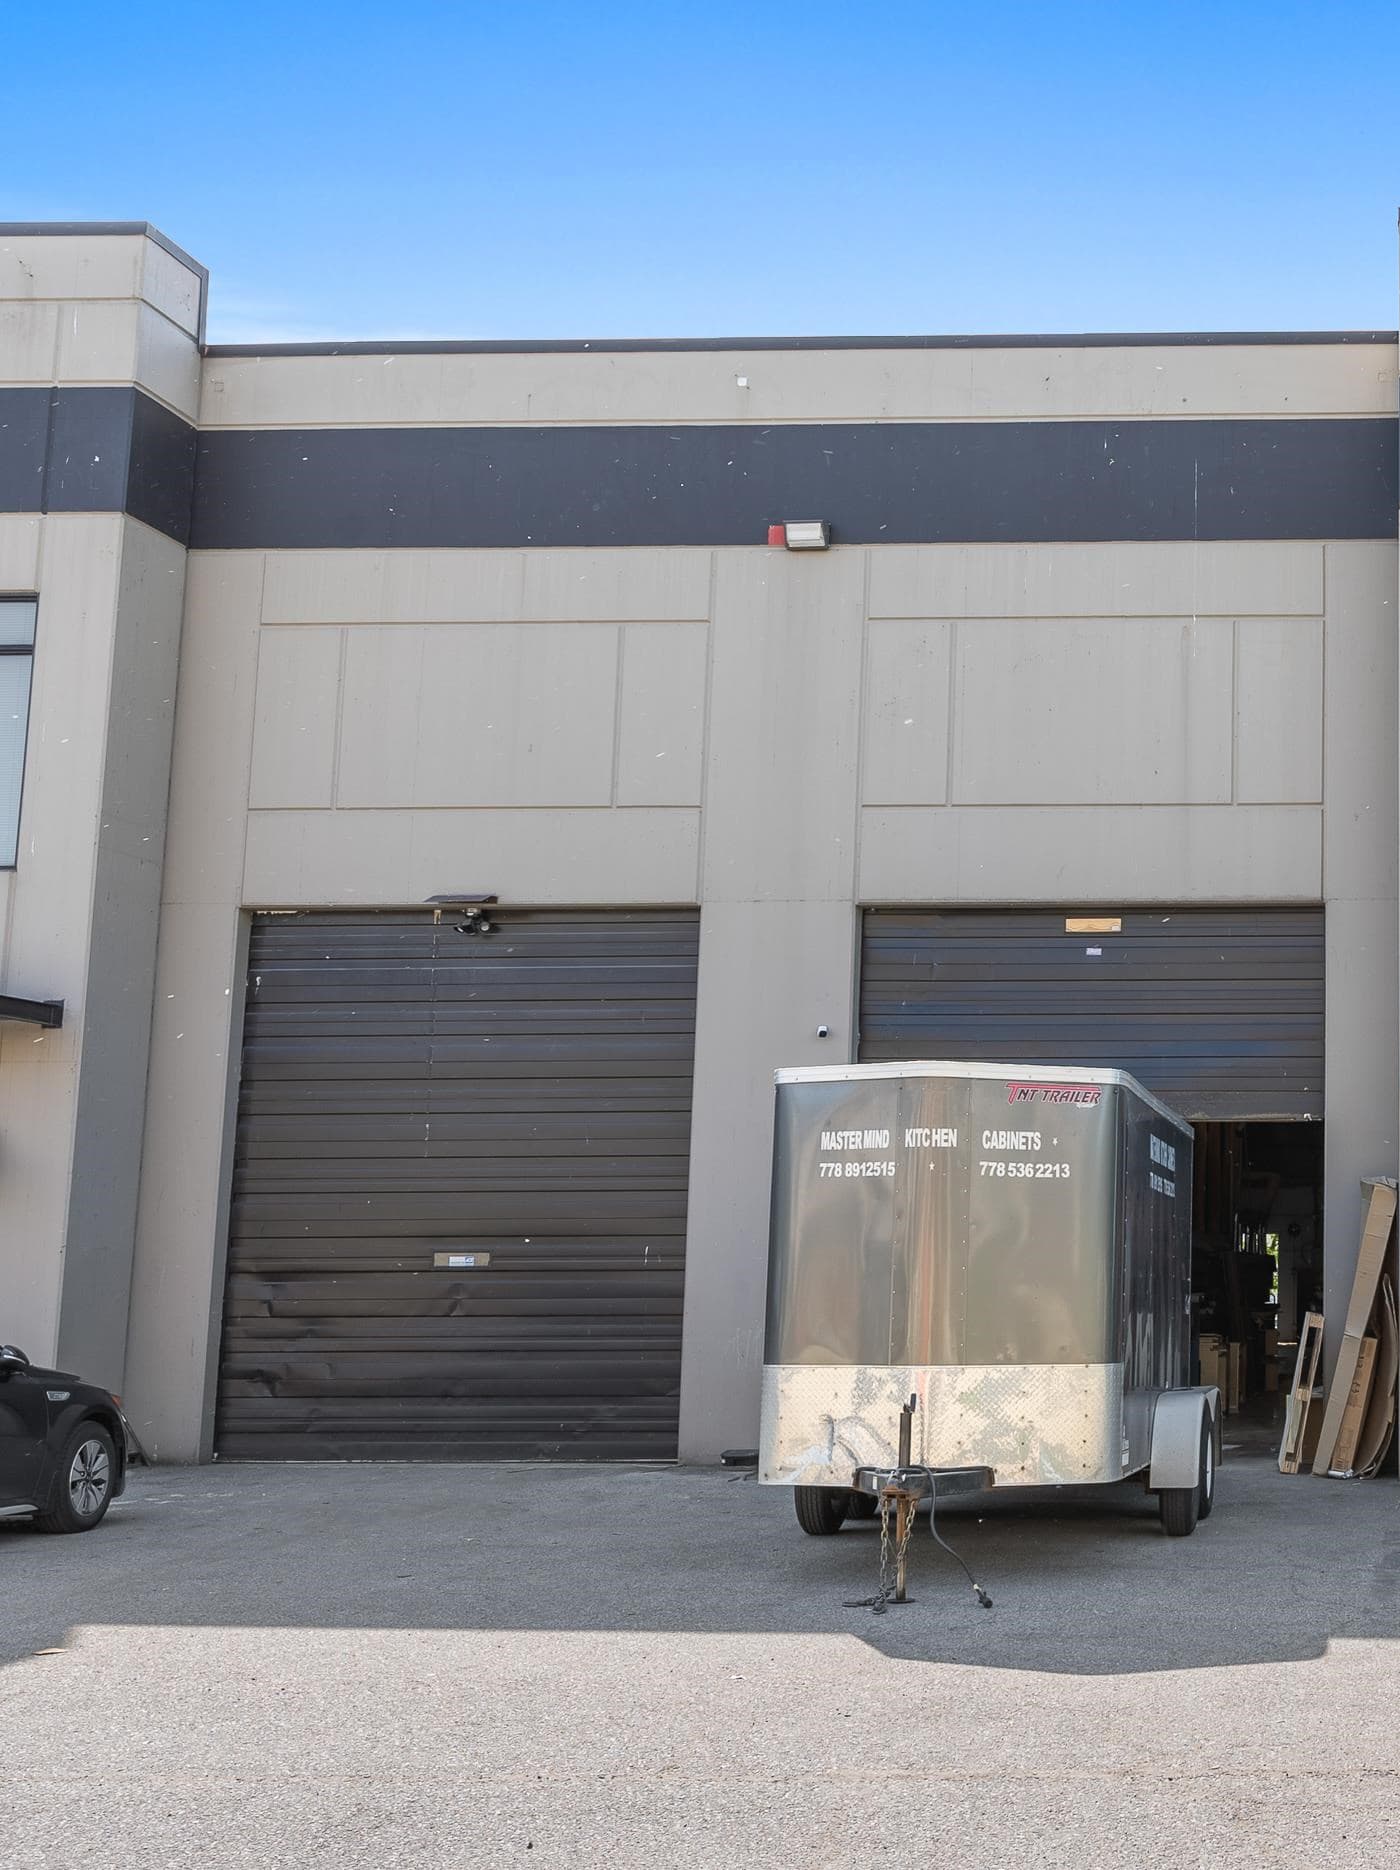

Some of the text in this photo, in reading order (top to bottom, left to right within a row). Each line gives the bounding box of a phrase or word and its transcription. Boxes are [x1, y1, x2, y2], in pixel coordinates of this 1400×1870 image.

[1006, 1083, 1102, 1105] TNT TRAILER
[904, 1128, 958, 1148] KITCHEN
[982, 1130, 1042, 1151] CABINETS
[819, 1161, 896, 1178] 778 8912515
[979, 1161, 1006, 1177] 778
